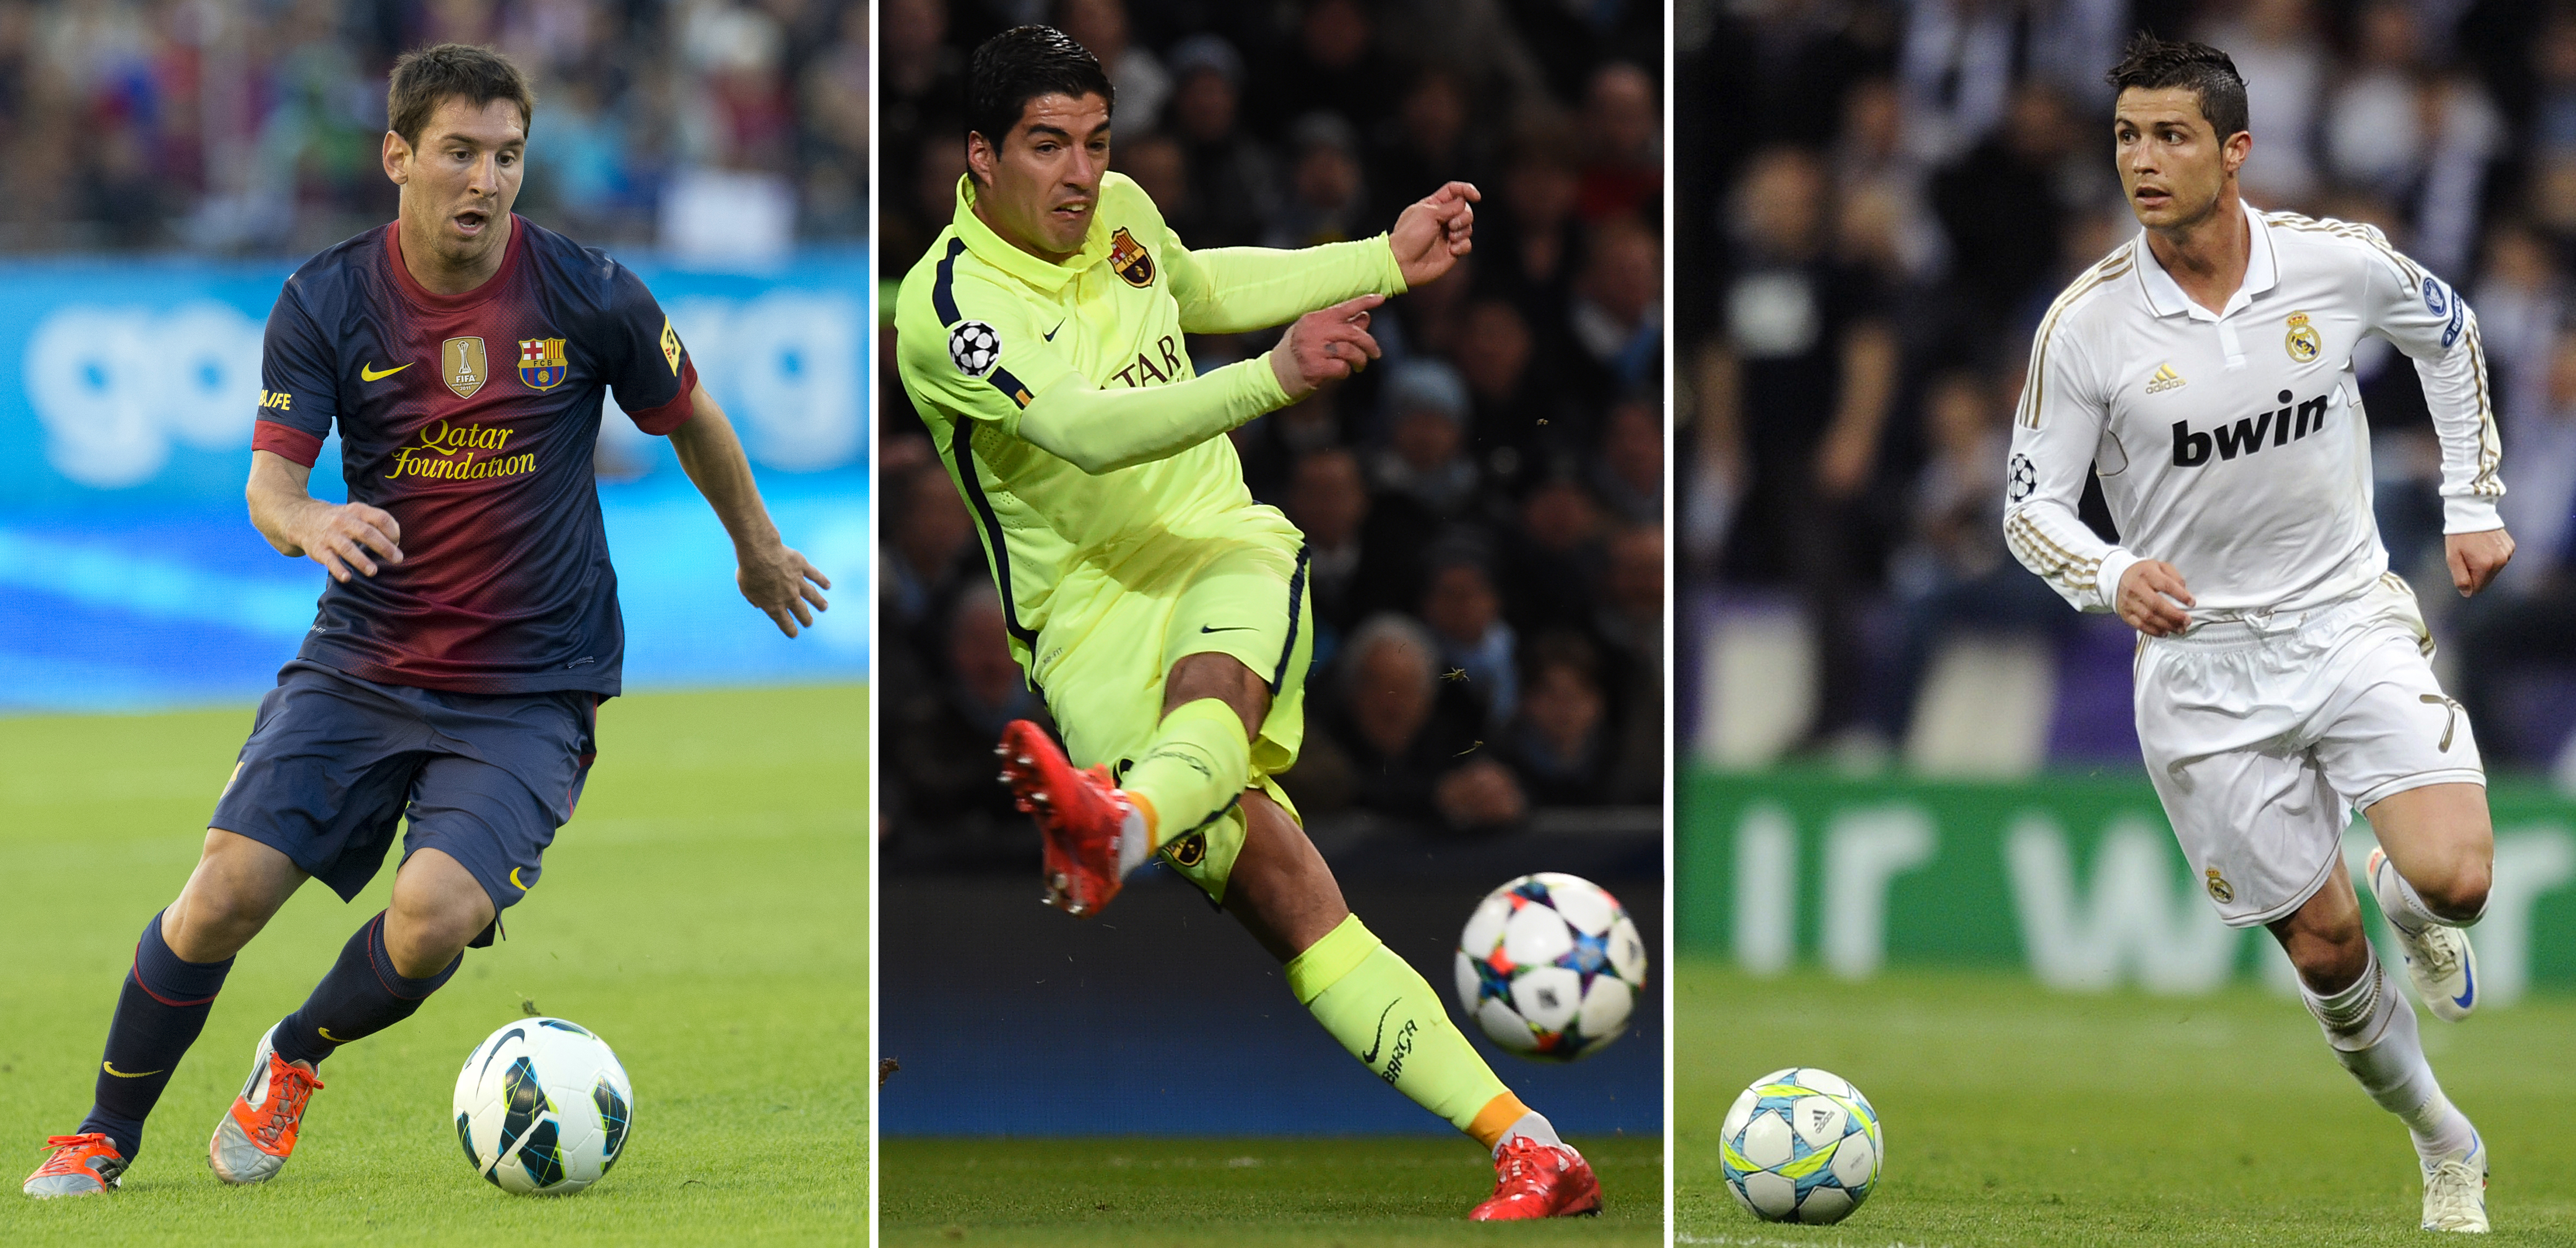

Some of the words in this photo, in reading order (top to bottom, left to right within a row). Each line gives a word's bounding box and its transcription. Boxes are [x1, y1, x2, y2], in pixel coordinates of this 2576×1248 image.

[1122, 254, 1137, 266] FCB
[667, 329, 676, 355] 3
[1099, 335, 1181, 388] TAR
[456, 375, 476, 383] FIFA
[2146, 379, 2187, 394] adidas
[420, 419, 514, 456] Qatar
[2172, 389, 2328, 467] bwin
[385, 447, 537, 479] Foundation
[2419, 694, 2455, 753] 7
[1382, 1019, 1418, 1085] BARÇA
